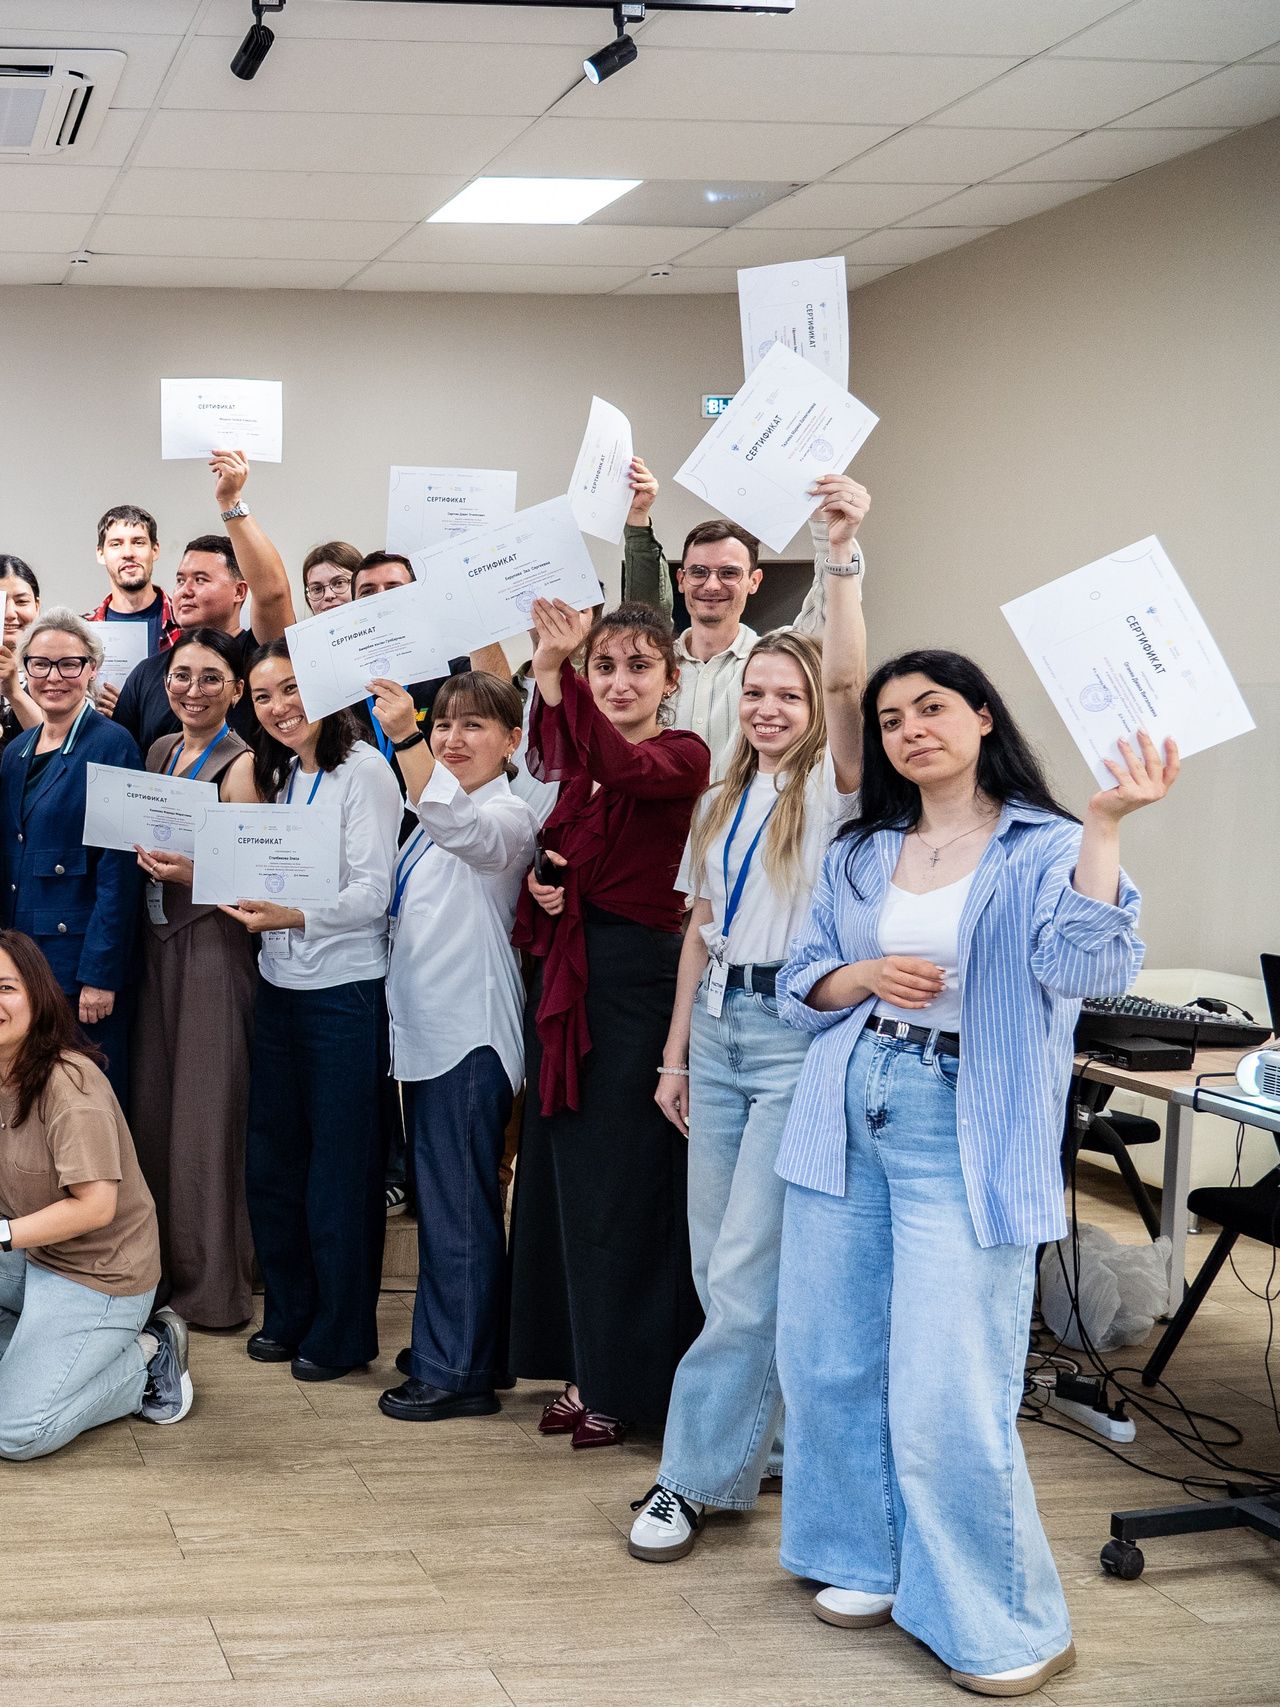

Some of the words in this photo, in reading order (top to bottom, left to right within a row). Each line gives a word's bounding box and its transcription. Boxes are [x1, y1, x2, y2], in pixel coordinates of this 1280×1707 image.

[806, 304, 816, 348] СЕРТИФИКАТ
[745, 414, 782, 462] СЕРТИФИКАТ
[591, 454, 606, 494] СЕРТИФИКАТ
[426, 496, 466, 504] СЕРТИФИКАТ
[468, 553, 518, 578] СЕРТИФИКАТ
[331, 626, 376, 647] СЕРТИФИКАТ
[1126, 614, 1166, 675] СЕРТИФИКАТ
[1131, 677, 1144, 693] Диана
[1140, 690, 1158, 719] Витальевна
[126, 792, 168, 803] СЕРТИФИКАТ
[238, 837, 282, 845] СЕРТИФИКАТ
